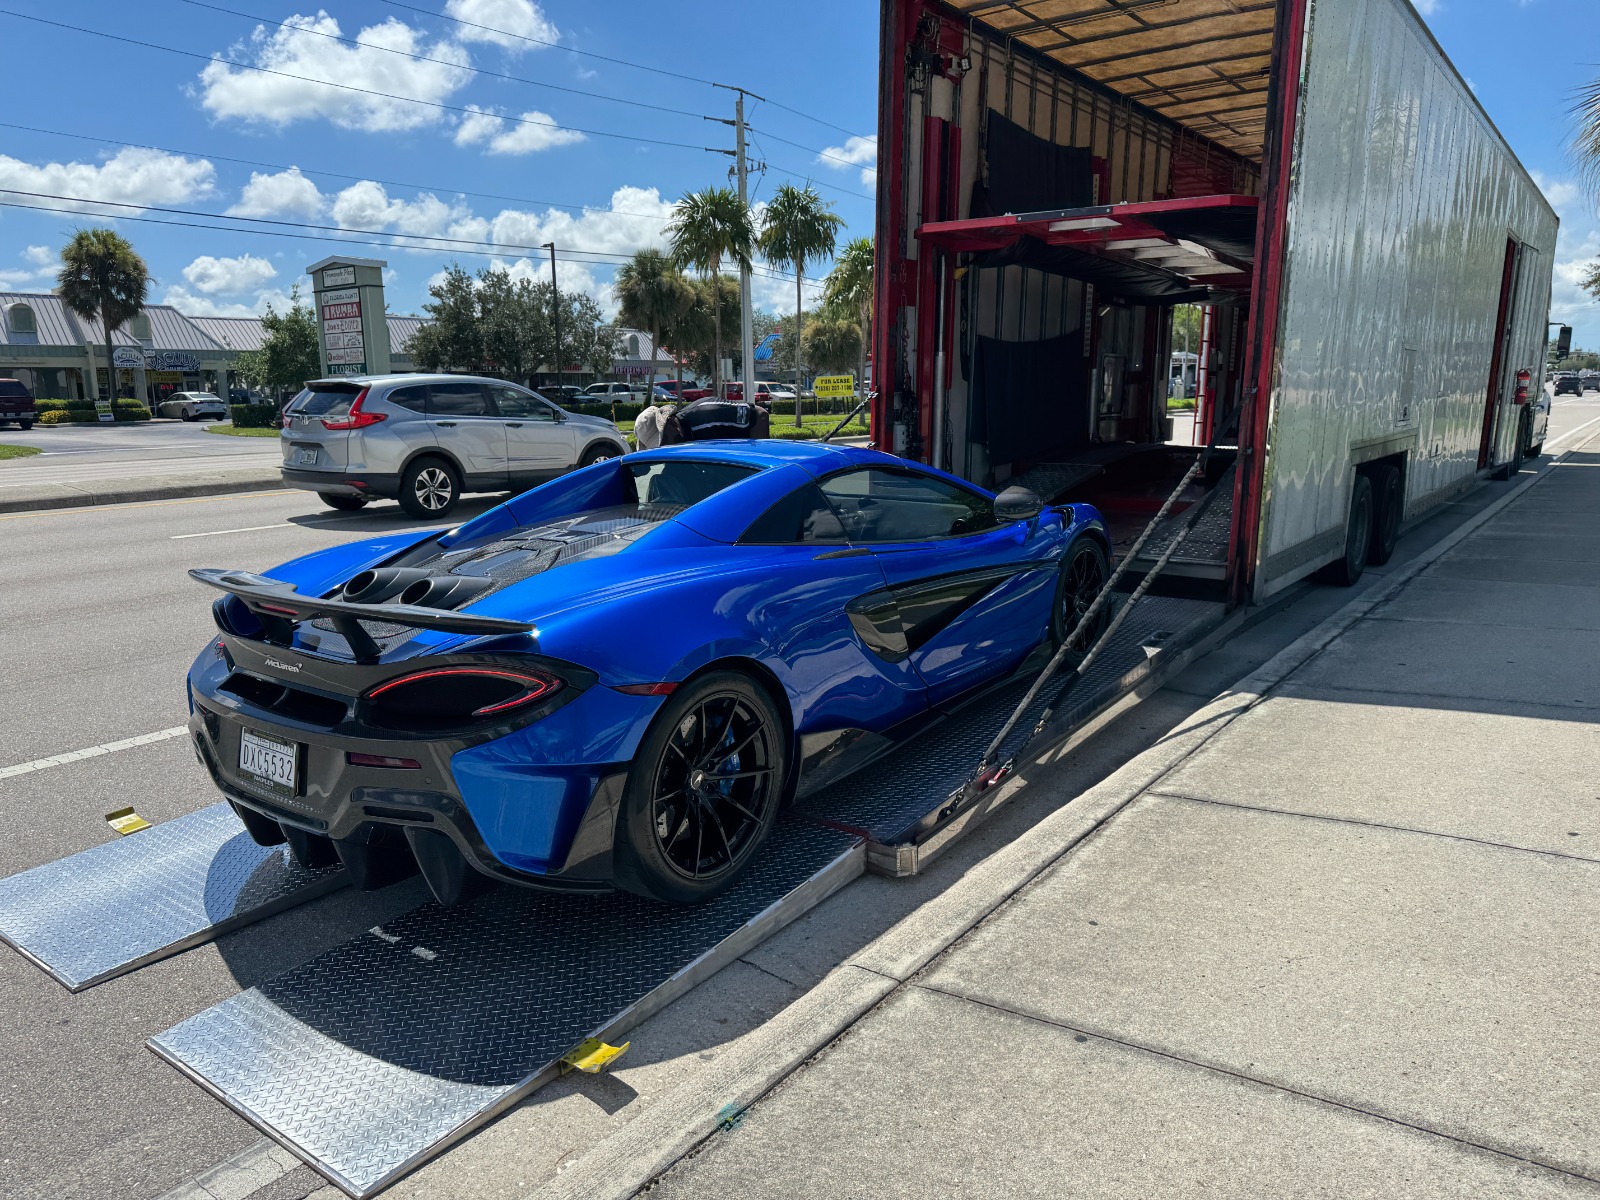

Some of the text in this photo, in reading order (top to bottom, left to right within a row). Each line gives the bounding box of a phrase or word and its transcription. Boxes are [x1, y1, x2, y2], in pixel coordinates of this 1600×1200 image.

[330, 303, 359, 315] RUMBA
[113, 352, 142, 362] VACUUM
[147, 352, 201, 372] VACUUM
[331, 364, 362, 374] FLORIST
[264, 658, 300, 673] McLaren
[243, 744, 293, 781] DXC5532
